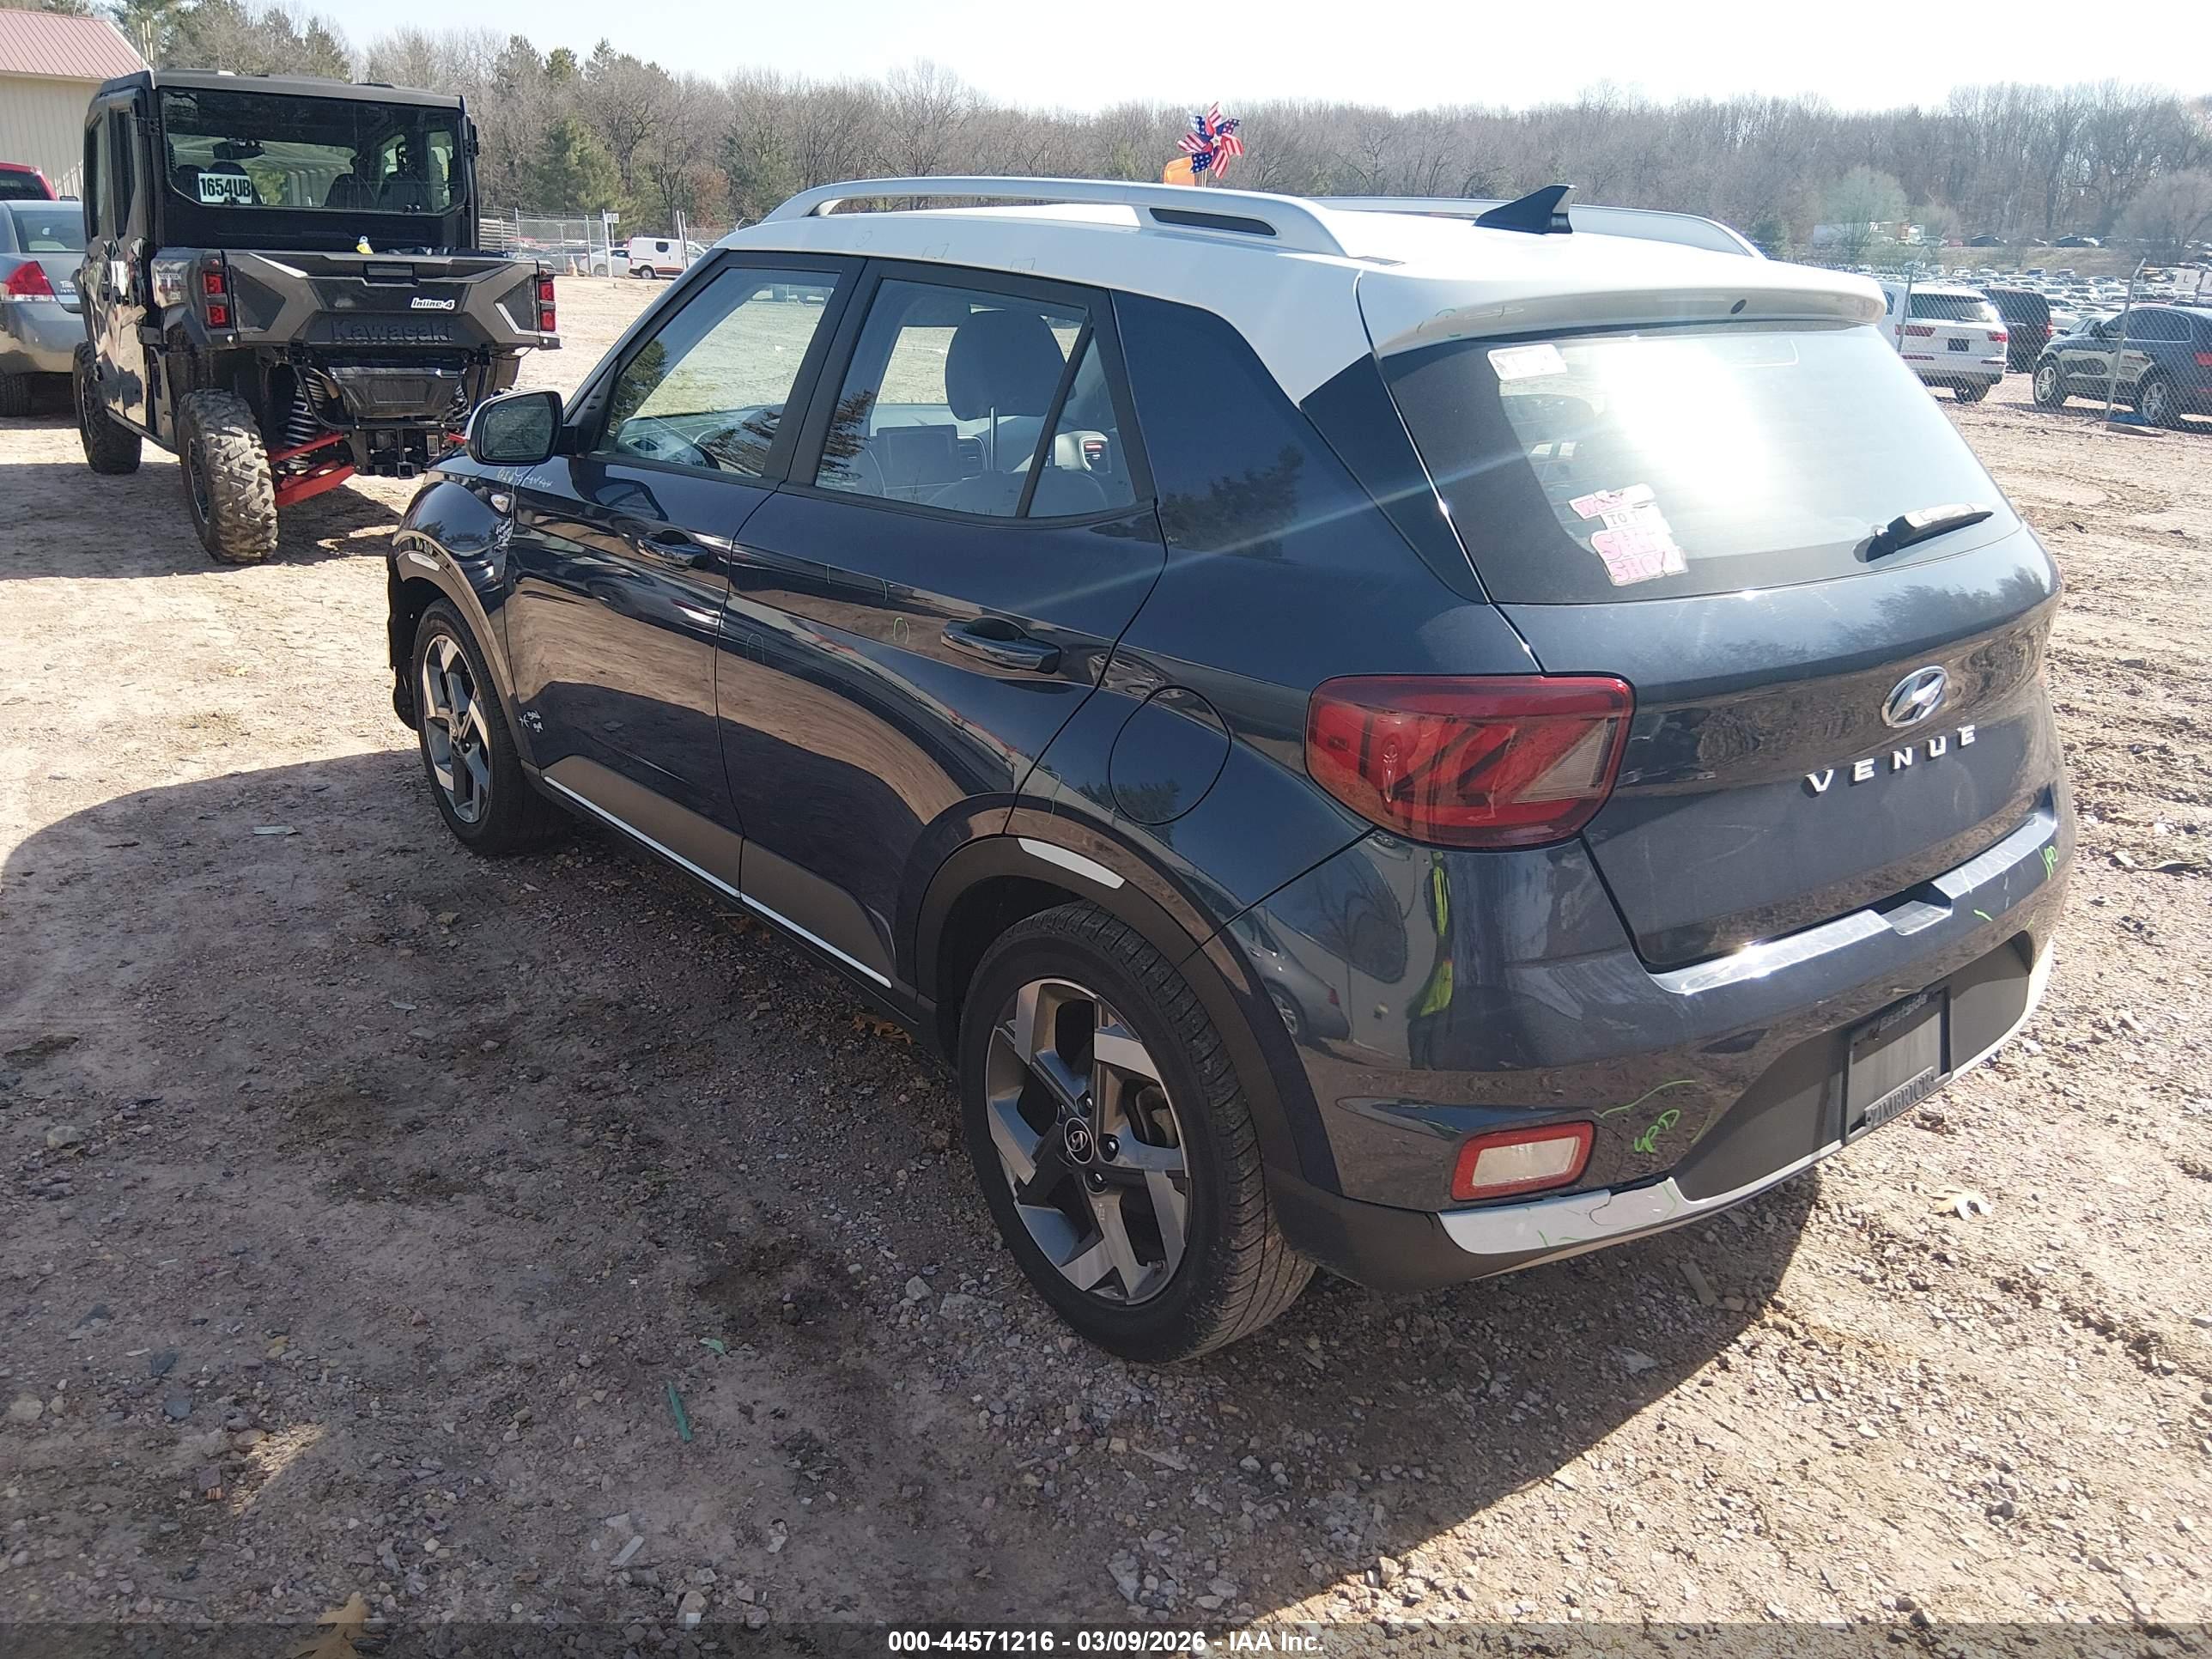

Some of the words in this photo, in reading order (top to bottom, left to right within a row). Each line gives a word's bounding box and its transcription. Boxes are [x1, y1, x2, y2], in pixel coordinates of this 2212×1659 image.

[200, 178, 252, 198] 1654UB
[331, 319, 454, 341] Kawasaki
[1805, 725, 1975, 793] VENUE
